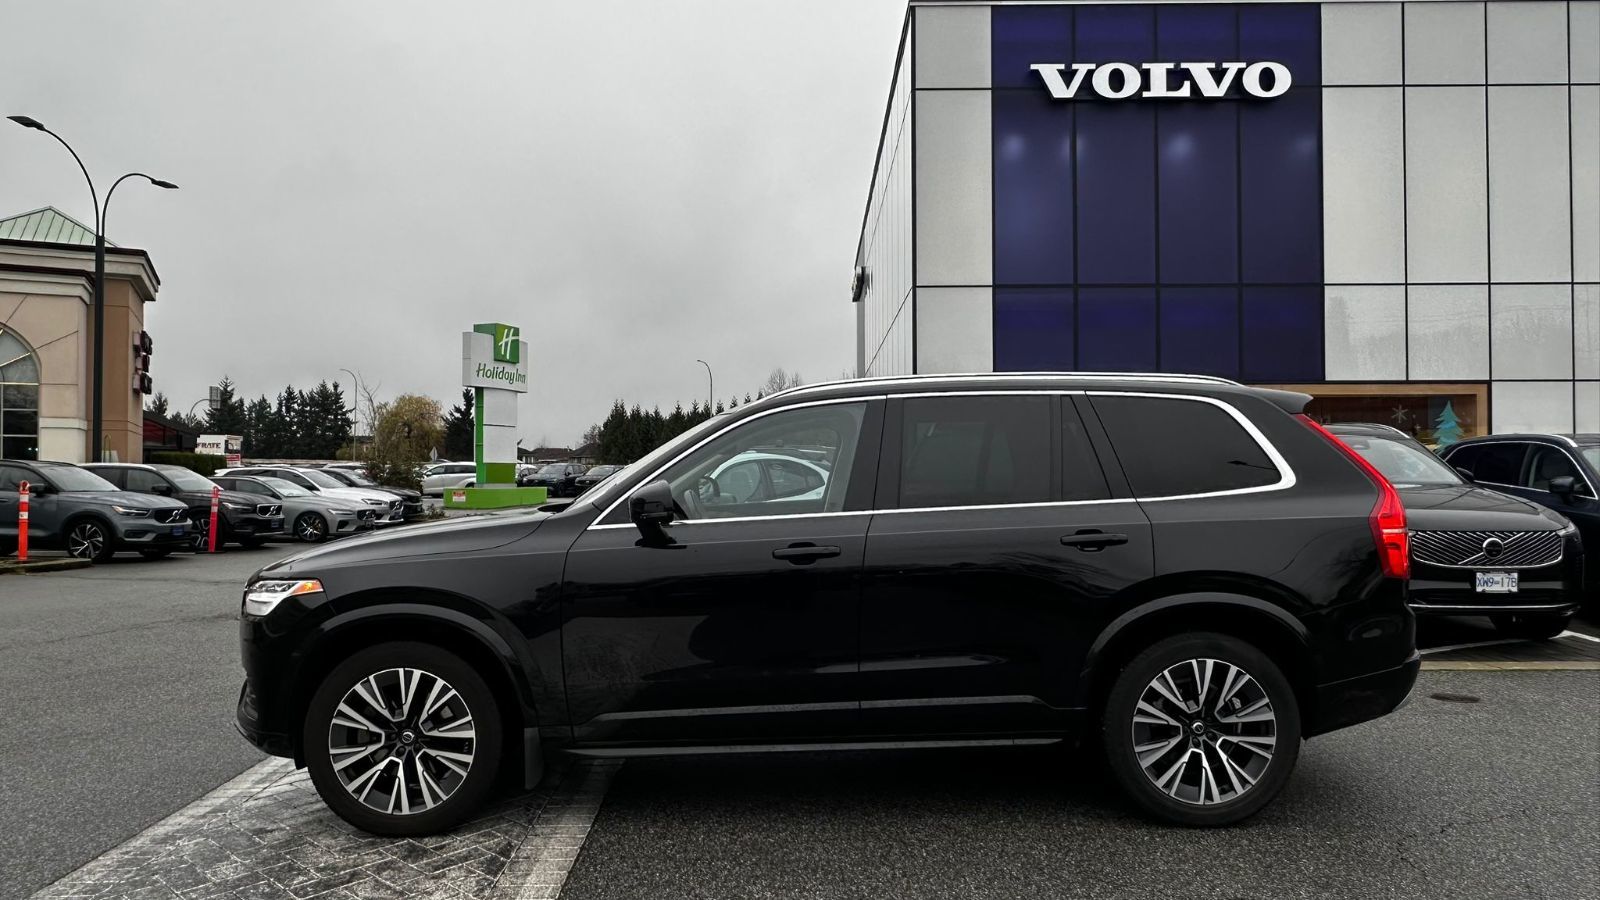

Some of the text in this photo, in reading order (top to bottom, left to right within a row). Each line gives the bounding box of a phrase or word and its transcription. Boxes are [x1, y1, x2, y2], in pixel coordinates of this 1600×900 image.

[1030, 62, 1292, 98] VOLVO
[499, 328, 519, 359] H
[476, 362, 526, 384] Holiday Inn
